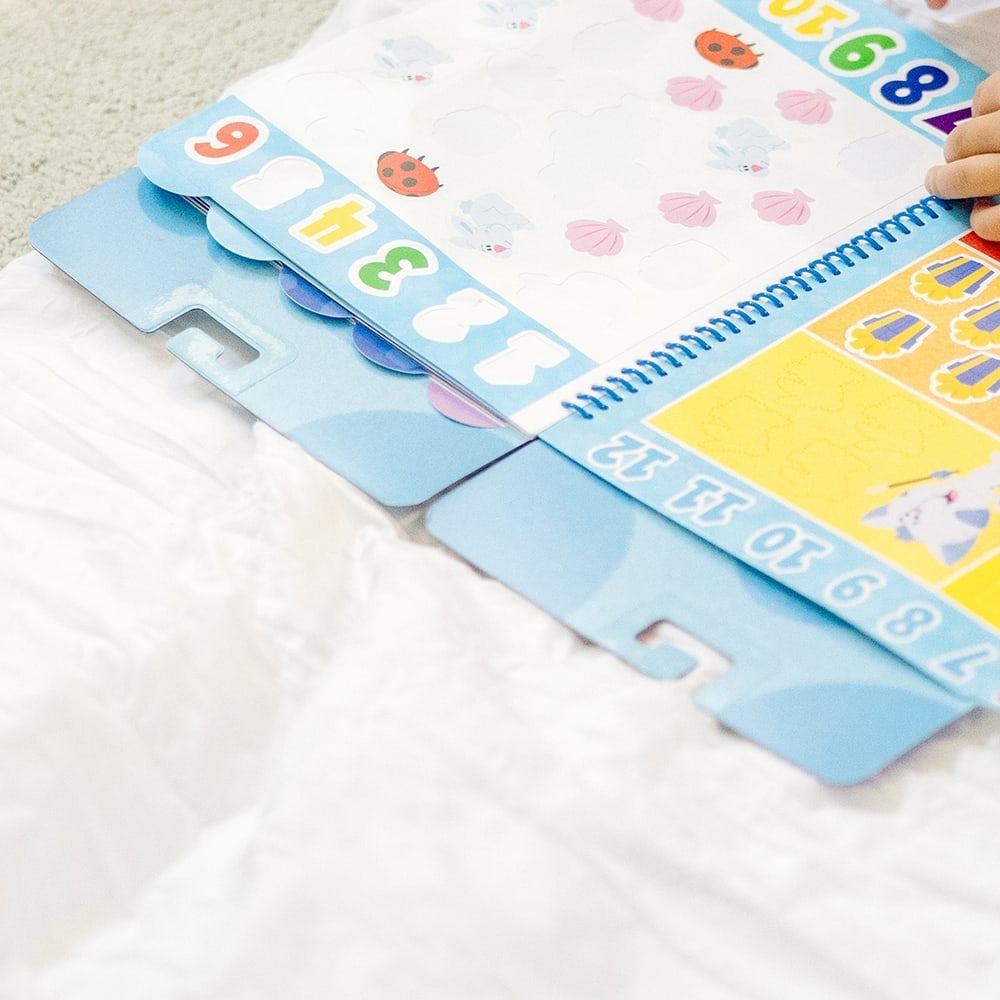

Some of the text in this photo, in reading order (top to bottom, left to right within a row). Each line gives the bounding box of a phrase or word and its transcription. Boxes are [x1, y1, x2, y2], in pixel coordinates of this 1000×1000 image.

[827, 33, 898, 72] 9
[880, 64, 950, 106] 8
[191, 120, 430, 292] 3 4 6
[589, 432, 998, 682] 7 8 9 10 11 12
